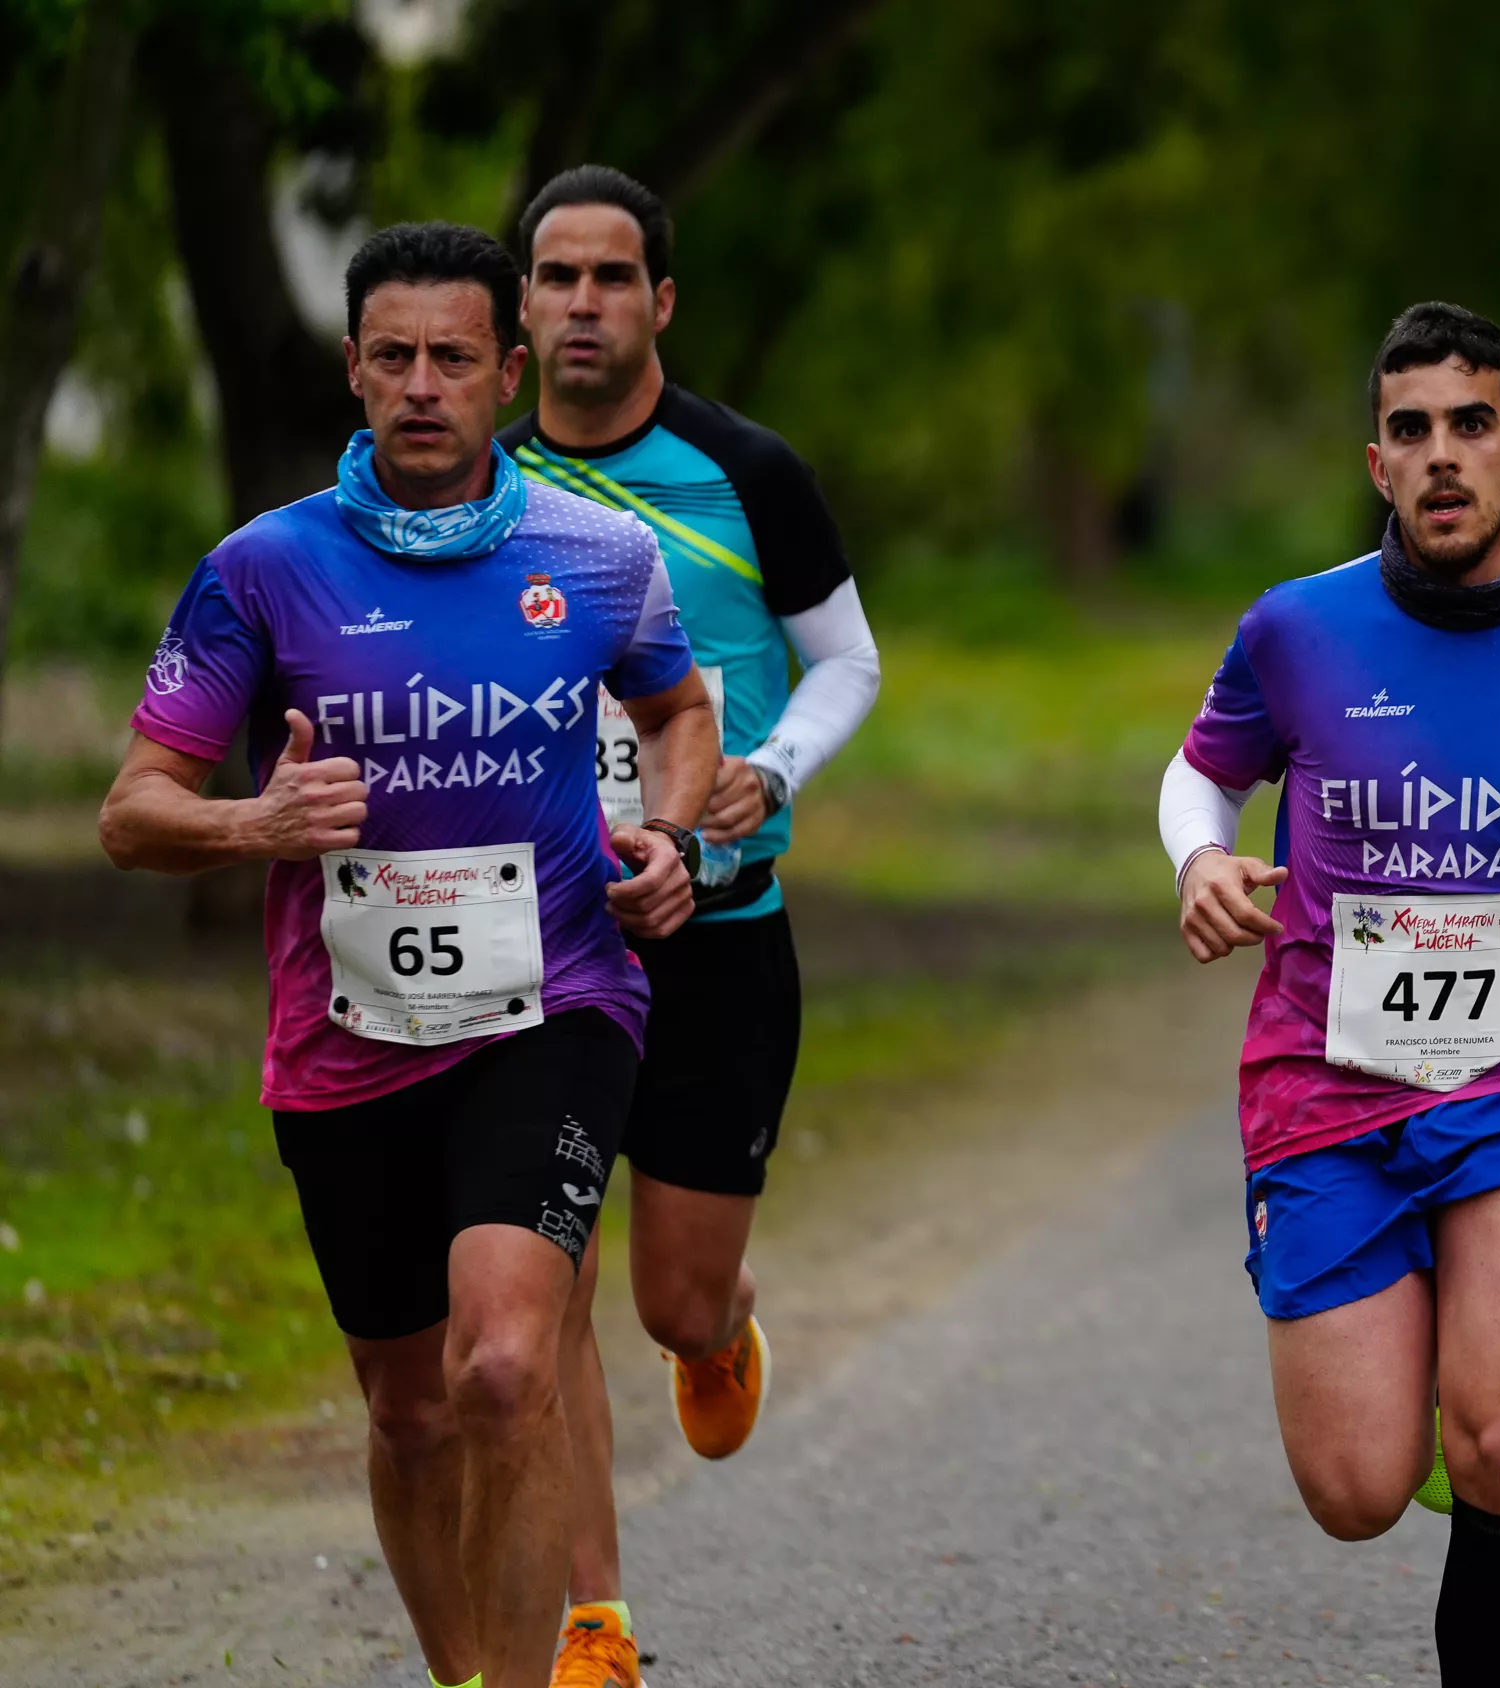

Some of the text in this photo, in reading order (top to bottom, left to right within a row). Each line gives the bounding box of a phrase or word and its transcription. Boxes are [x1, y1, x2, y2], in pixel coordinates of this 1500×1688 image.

[340, 620, 414, 635] TEAMERGY
[317, 672, 590, 745] FILÍPIDES
[1345, 704, 1415, 718] TEAMERGY
[364, 745, 546, 794] PARADAS
[396, 887, 466, 905] LUCENA
[1414, 931, 1484, 951] LUCENA
[389, 925, 464, 977] 65
[1382, 969, 1496, 1022] 477
[1386, 1036, 1495, 1046] FRANCISCO LÓPEZ BENJUMEA
[1420, 1048, 1461, 1056] M-Hombre
